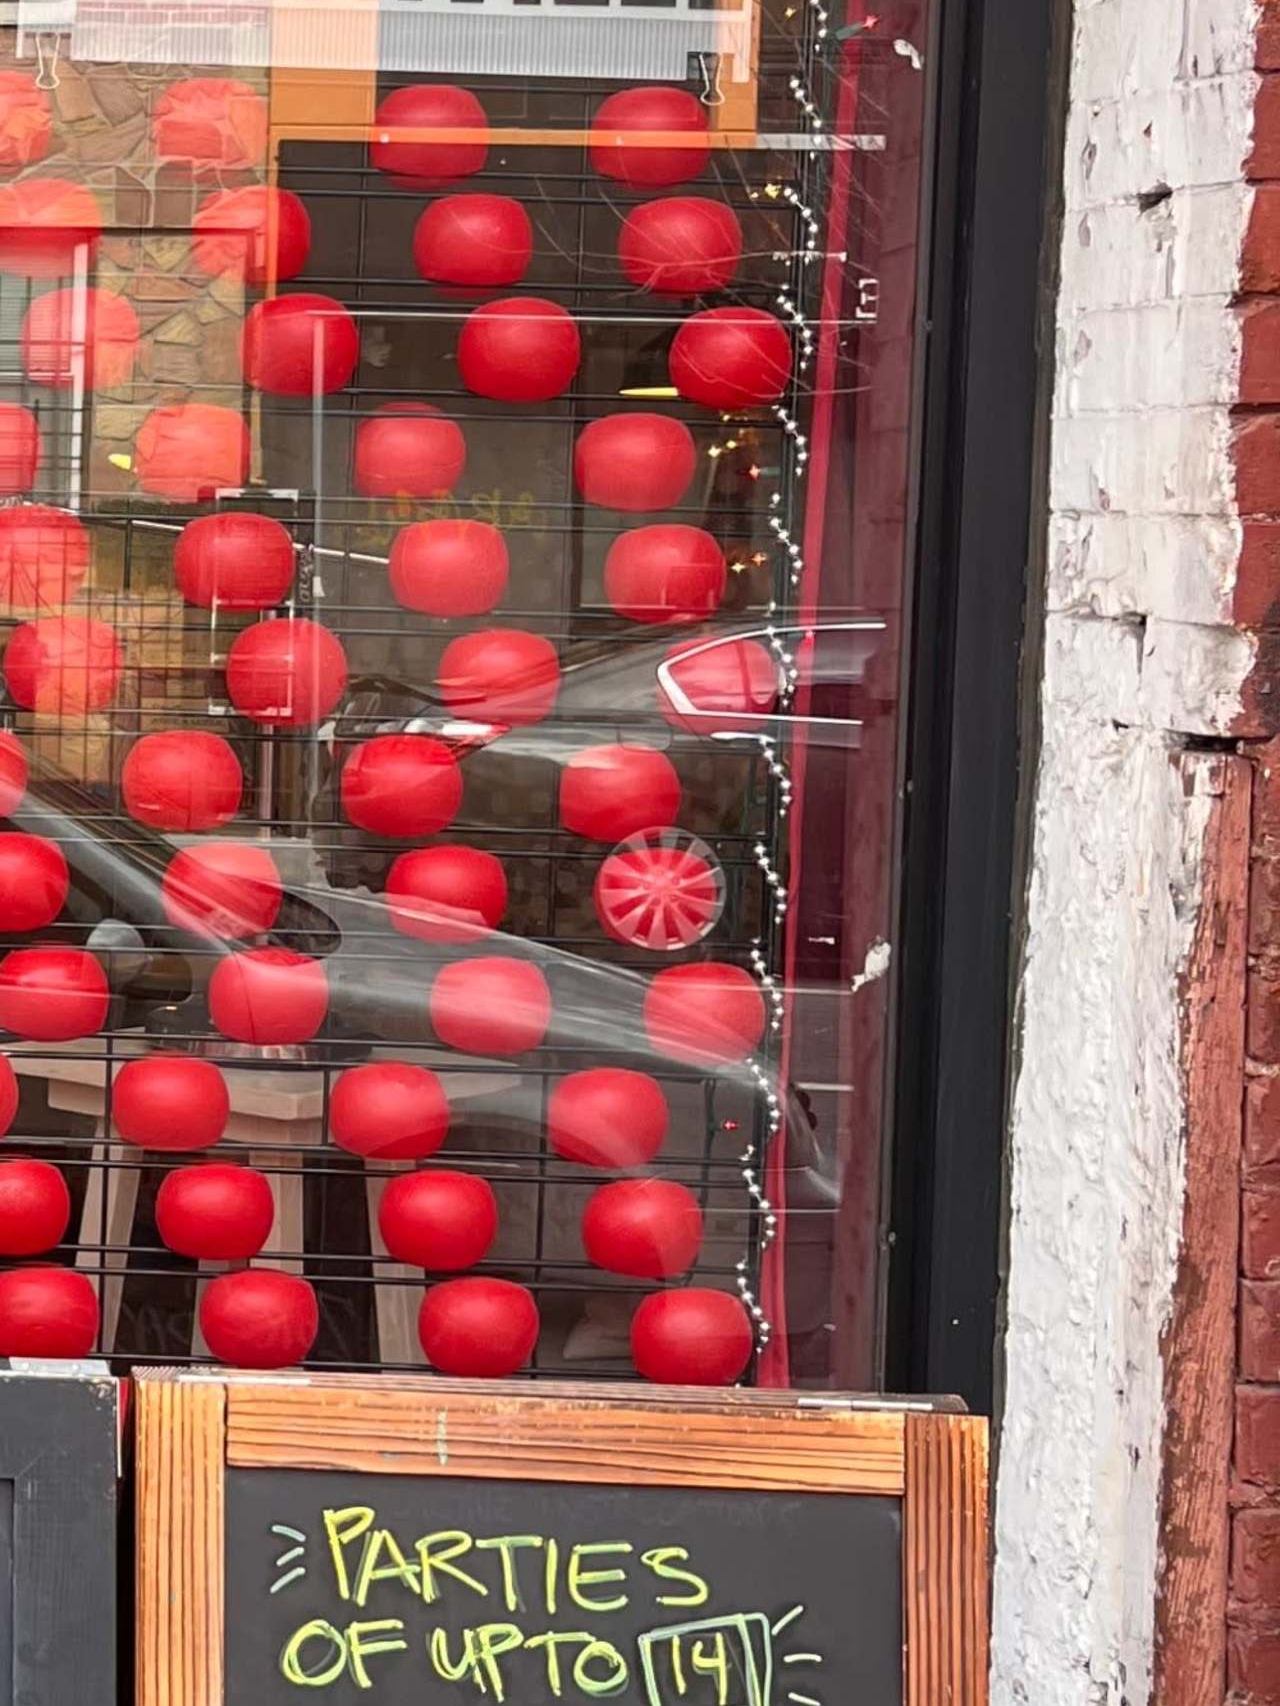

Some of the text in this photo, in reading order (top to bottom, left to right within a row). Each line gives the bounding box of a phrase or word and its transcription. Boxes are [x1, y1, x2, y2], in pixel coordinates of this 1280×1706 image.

[324, 1506, 710, 1613] PARTIES
[280, 1618, 408, 1688] OF
[670, 1632, 731, 1706] 14
